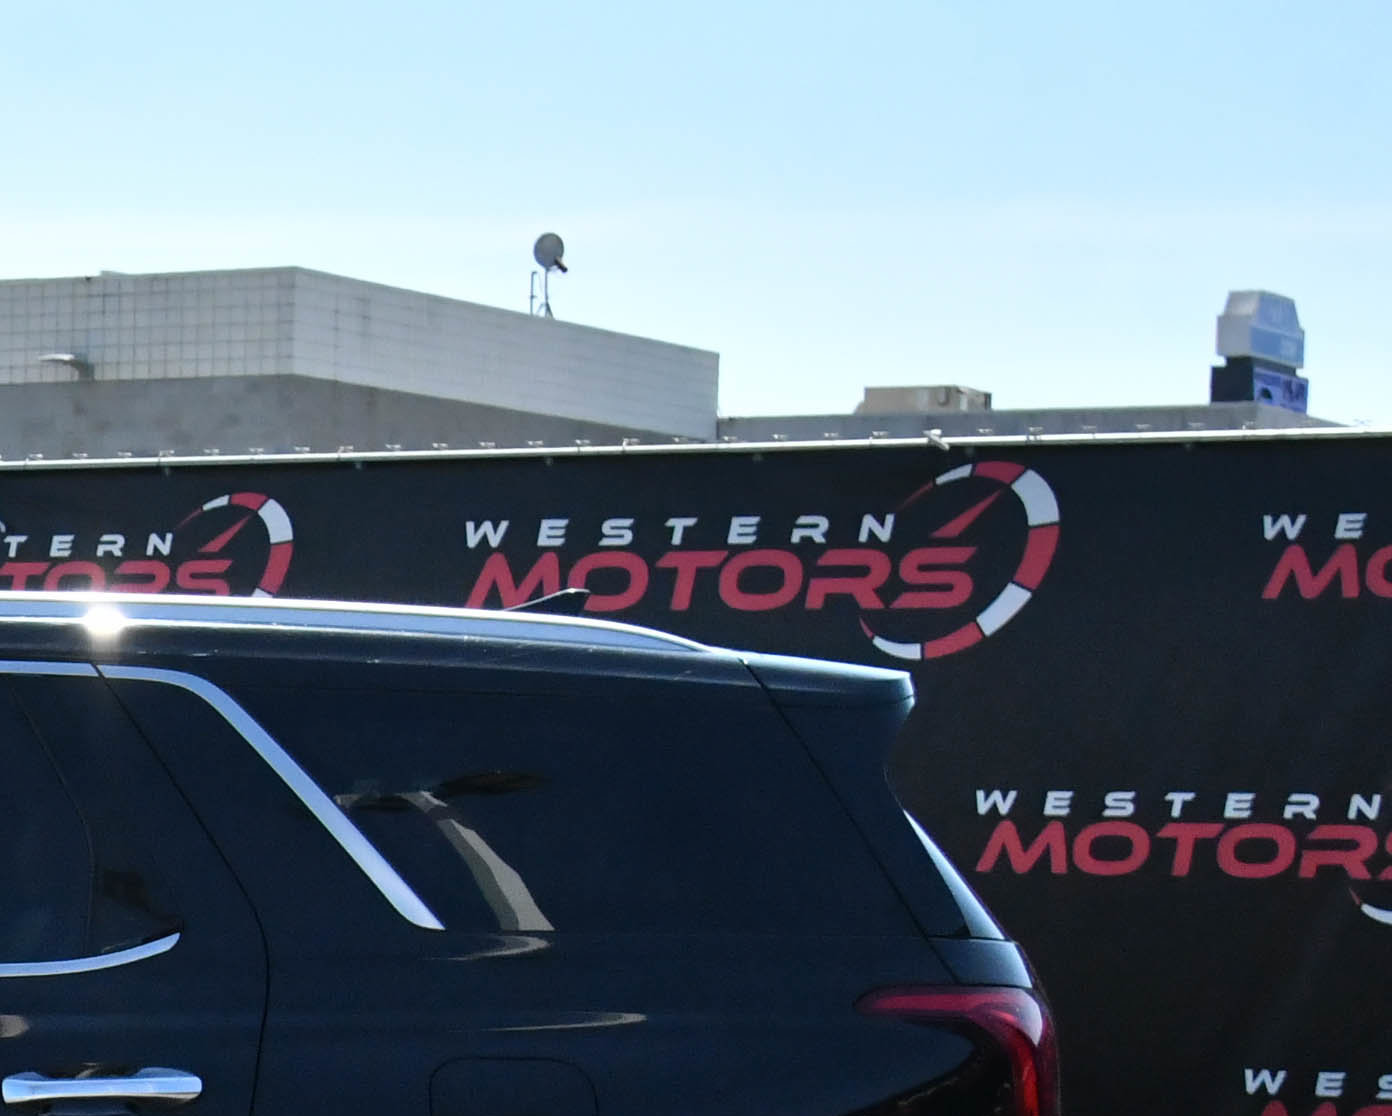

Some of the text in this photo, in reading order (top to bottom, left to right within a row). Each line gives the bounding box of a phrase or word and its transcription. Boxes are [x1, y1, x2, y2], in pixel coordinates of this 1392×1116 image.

[465, 514, 895, 549] WESTERN
[462, 546, 978, 612] MOTORS
[976, 789, 1382, 820] WESTERN
[975, 820, 1392, 881] MOTOR
